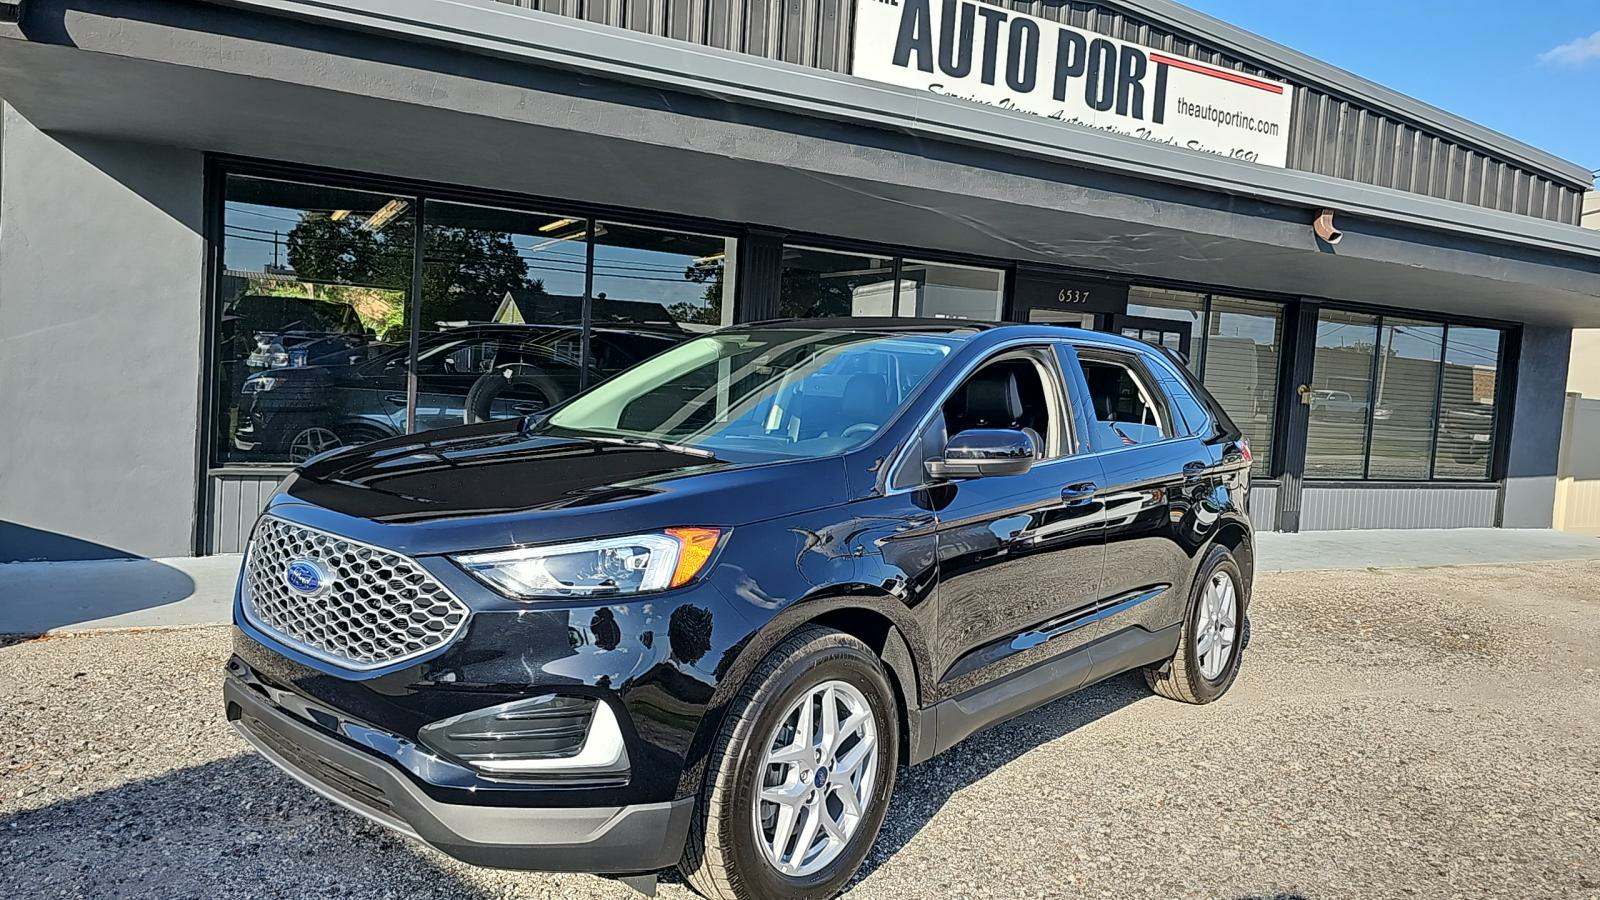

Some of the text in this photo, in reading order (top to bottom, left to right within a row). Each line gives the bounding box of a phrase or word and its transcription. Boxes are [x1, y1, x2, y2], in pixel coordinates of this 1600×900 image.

[892, 0, 1169, 124] AUTO PORT
[1177, 97, 1279, 136] theautoportinc.com
[1058, 289, 1090, 303] 6537
